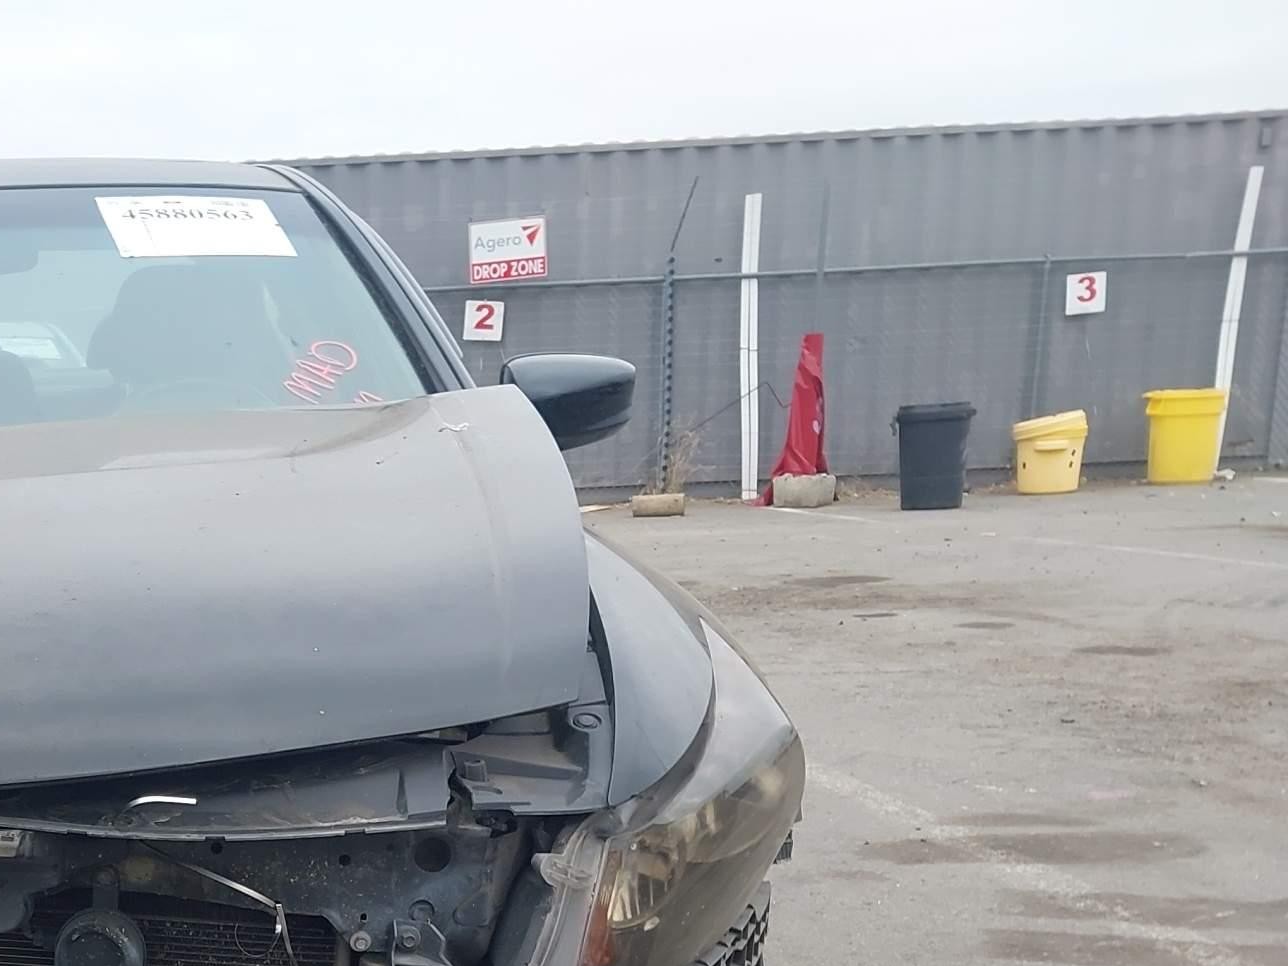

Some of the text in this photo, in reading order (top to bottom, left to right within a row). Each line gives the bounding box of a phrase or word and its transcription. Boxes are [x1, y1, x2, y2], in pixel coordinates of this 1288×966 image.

[122, 207, 254, 222] 45880563
[474, 236, 522, 253] Agero
[473, 258, 545, 280] DROP ZONE
[1076, 275, 1097, 302] 3
[473, 304, 496, 330] 2
